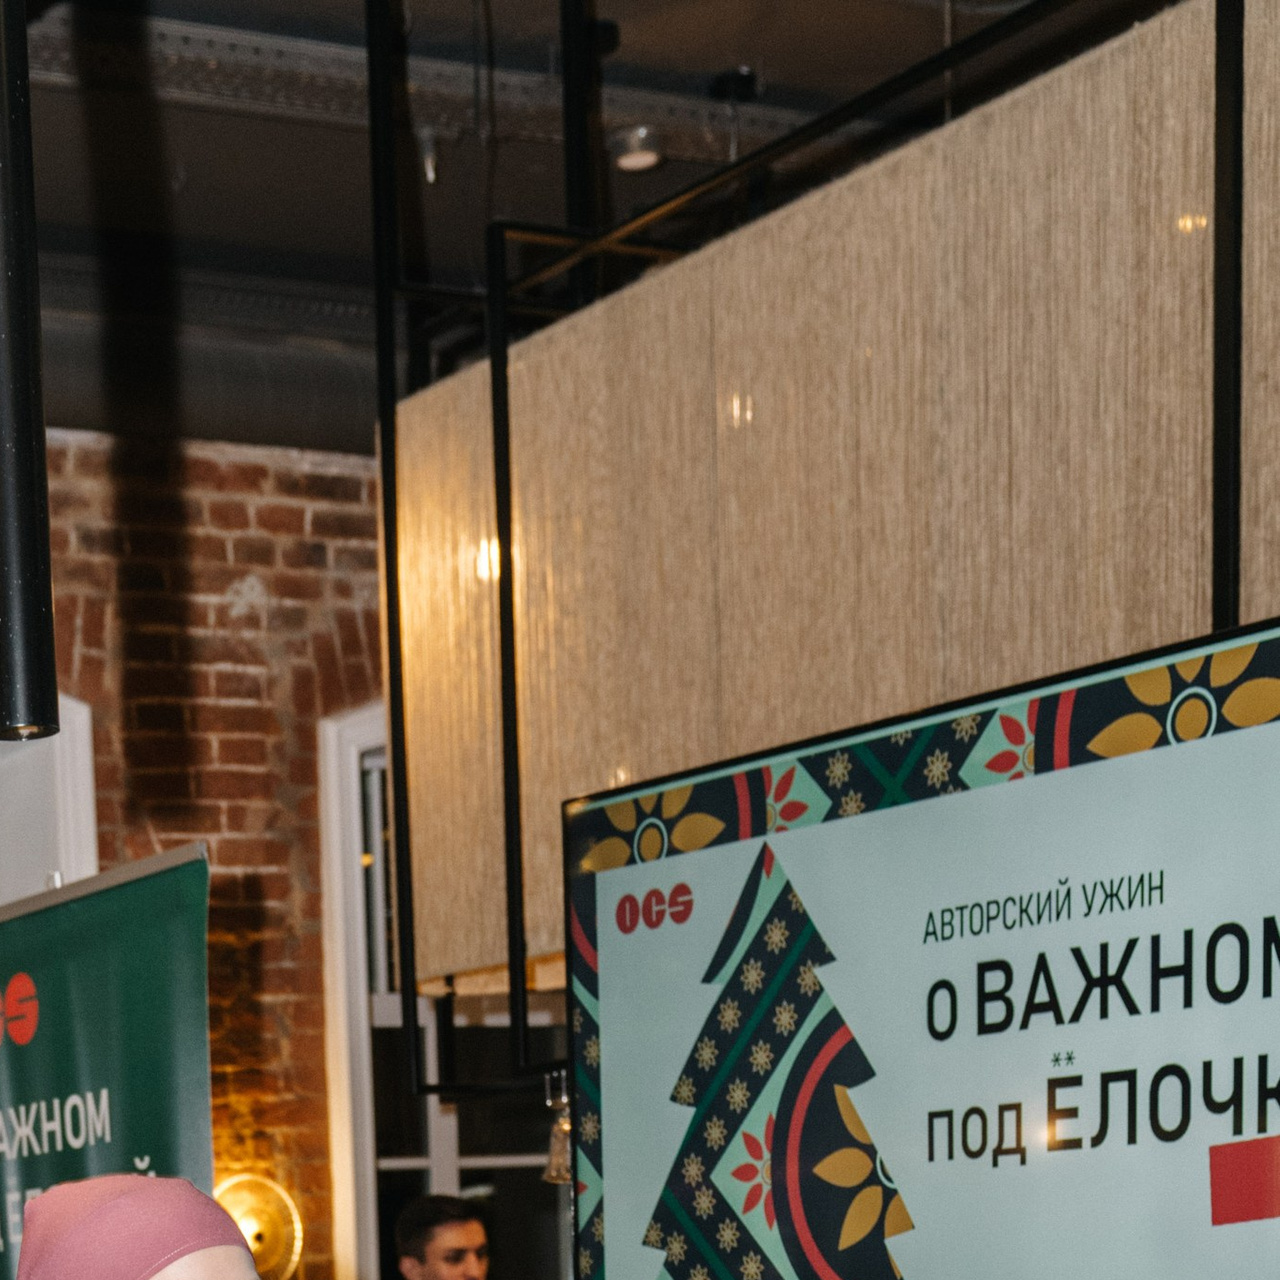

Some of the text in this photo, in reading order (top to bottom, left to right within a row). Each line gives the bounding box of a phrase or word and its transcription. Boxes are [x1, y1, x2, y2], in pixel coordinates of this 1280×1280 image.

[923, 870, 1164, 944] АВТОРСКИЙ УЖИН
[928, 1102, 1026, 1168] под
